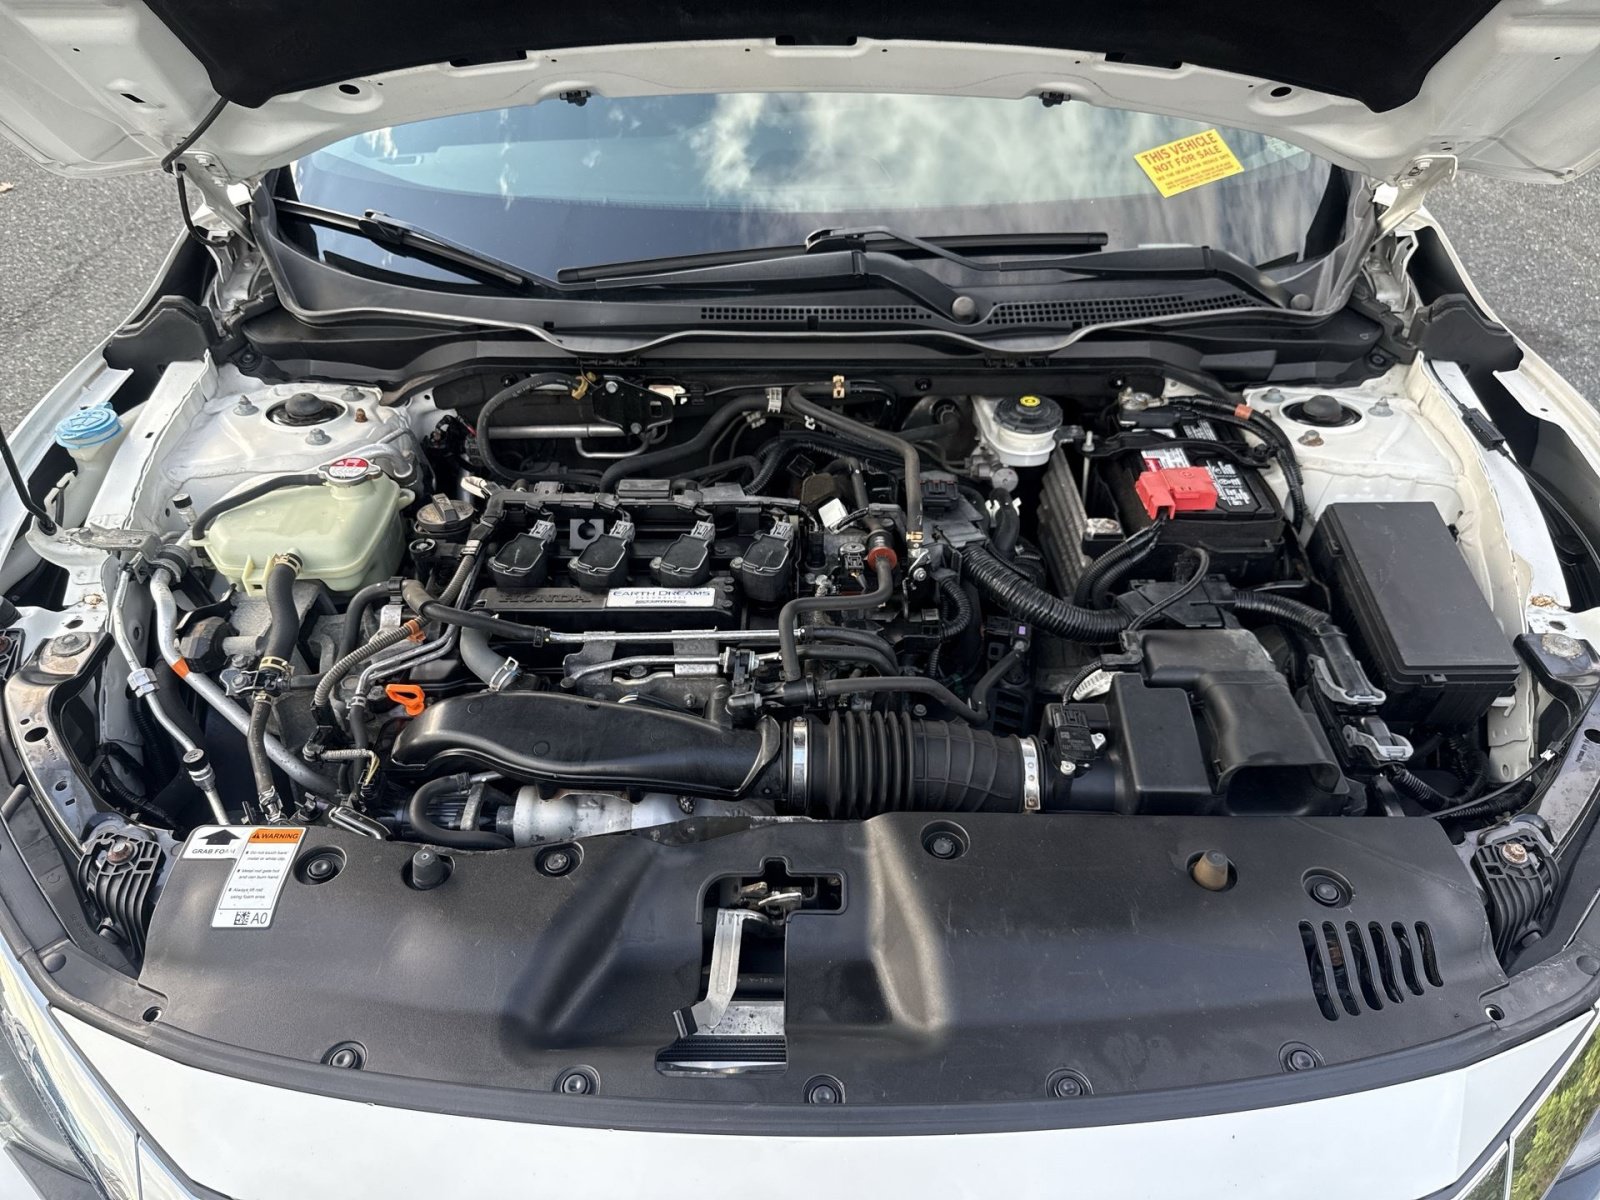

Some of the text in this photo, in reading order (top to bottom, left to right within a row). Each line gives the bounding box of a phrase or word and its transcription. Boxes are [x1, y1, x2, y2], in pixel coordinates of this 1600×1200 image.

[1141, 132, 1218, 166] THIS VEHICLE
[1152, 161, 1174, 174] NOT
[1174, 153, 1197, 167] FOR
[1196, 145, 1222, 159] SALE
[499, 593, 592, 603] HONDA
[250, 912, 268, 924] A0
